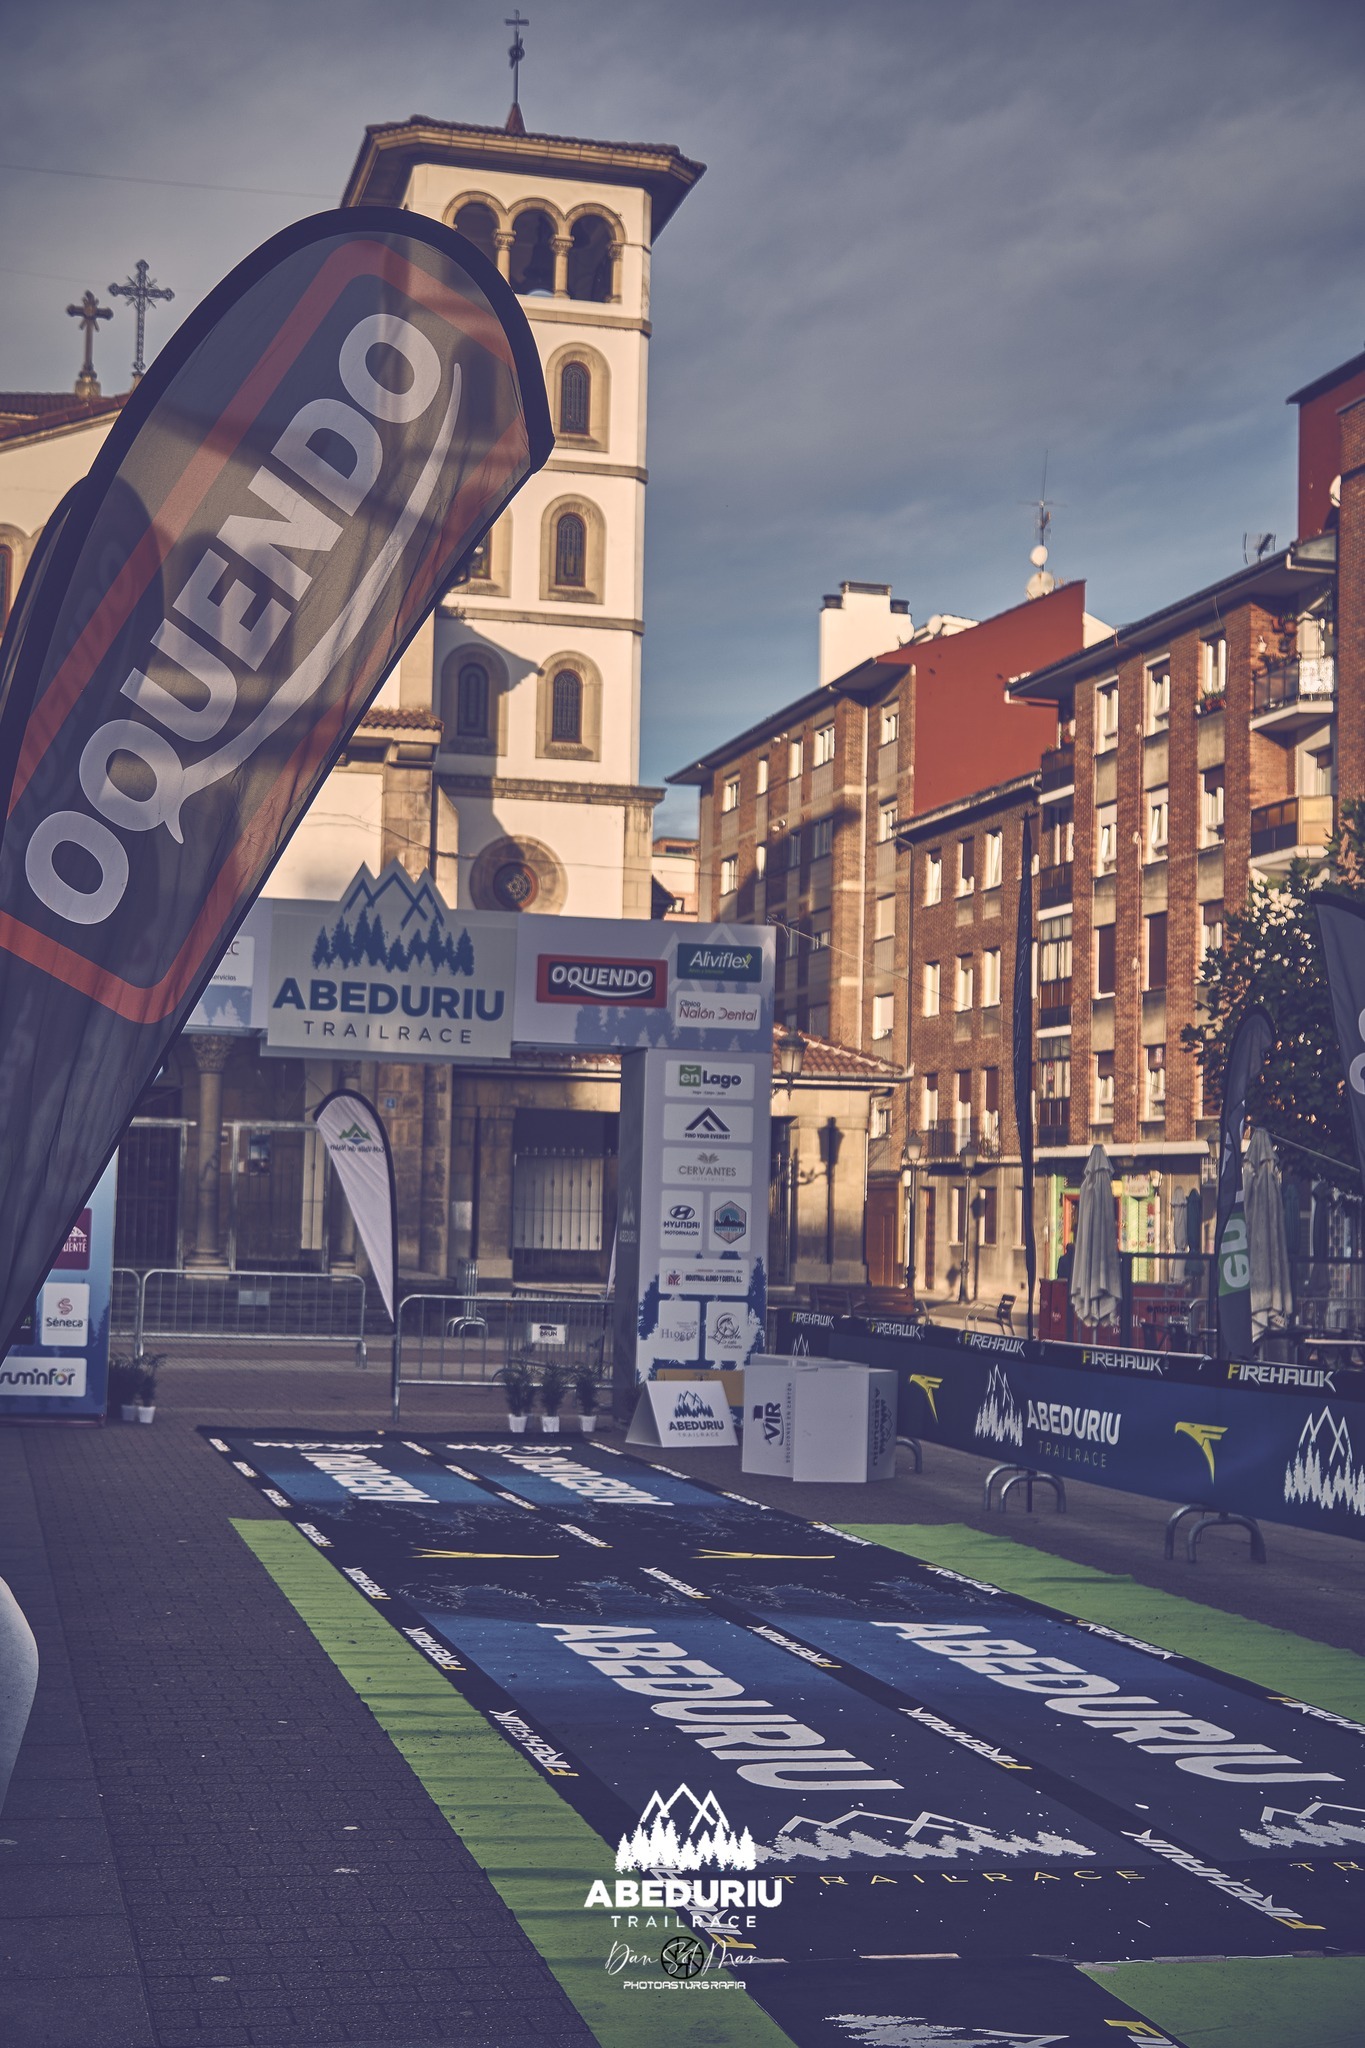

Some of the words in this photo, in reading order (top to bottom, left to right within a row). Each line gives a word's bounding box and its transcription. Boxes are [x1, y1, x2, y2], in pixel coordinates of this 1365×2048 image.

[25, 313, 442, 925] OQUENDO
[690, 950, 752, 969] Aliviflex
[213, 973, 237, 981] ervicios
[552, 965, 653, 988] OQUENDO
[272, 977, 505, 1021] ABEDURIU
[718, 1009, 758, 1021] Dental
[304, 1020, 472, 1044] TRAILRACE
[703, 1070, 742, 1089] Lago
[678, 1165, 737, 1177] CERVANTES
[663, 1220, 700, 1229] HYUNDAI
[63, 1243, 87, 1252] UENTE
[46, 1317, 84, 1328] Séneca
[791, 1311, 834, 1329] FIREHAWK
[871, 1320, 921, 1340] FIREHAWK
[965, 1332, 1026, 1357] FIREHAWK
[1082, 1350, 1164, 1376] FIREHAWK
[1228, 1363, 1337, 1393] FIREHAWK
[668, 1420, 725, 1431] ABEDURIU
[764, 1402, 781, 1442] VIR
[1026, 1399, 1122, 1446] ABEDURIU
[1039, 1440, 1107, 1468] TRAILRACE
[402, 1627, 467, 1671] FIREHAWK
[747, 1625, 842, 1668] FIREHAWK
[536, 1623, 905, 1791] ABEDURIU
[870, 1620, 1346, 1783] ABEDURIU
[489, 1709, 580, 1777] FIREHAWK
[899, 1707, 1033, 1770] FIREHAWK
[773, 1869, 1146, 1885] TRAILRACE
[1120, 1829, 1327, 1930] FIREHAWK
